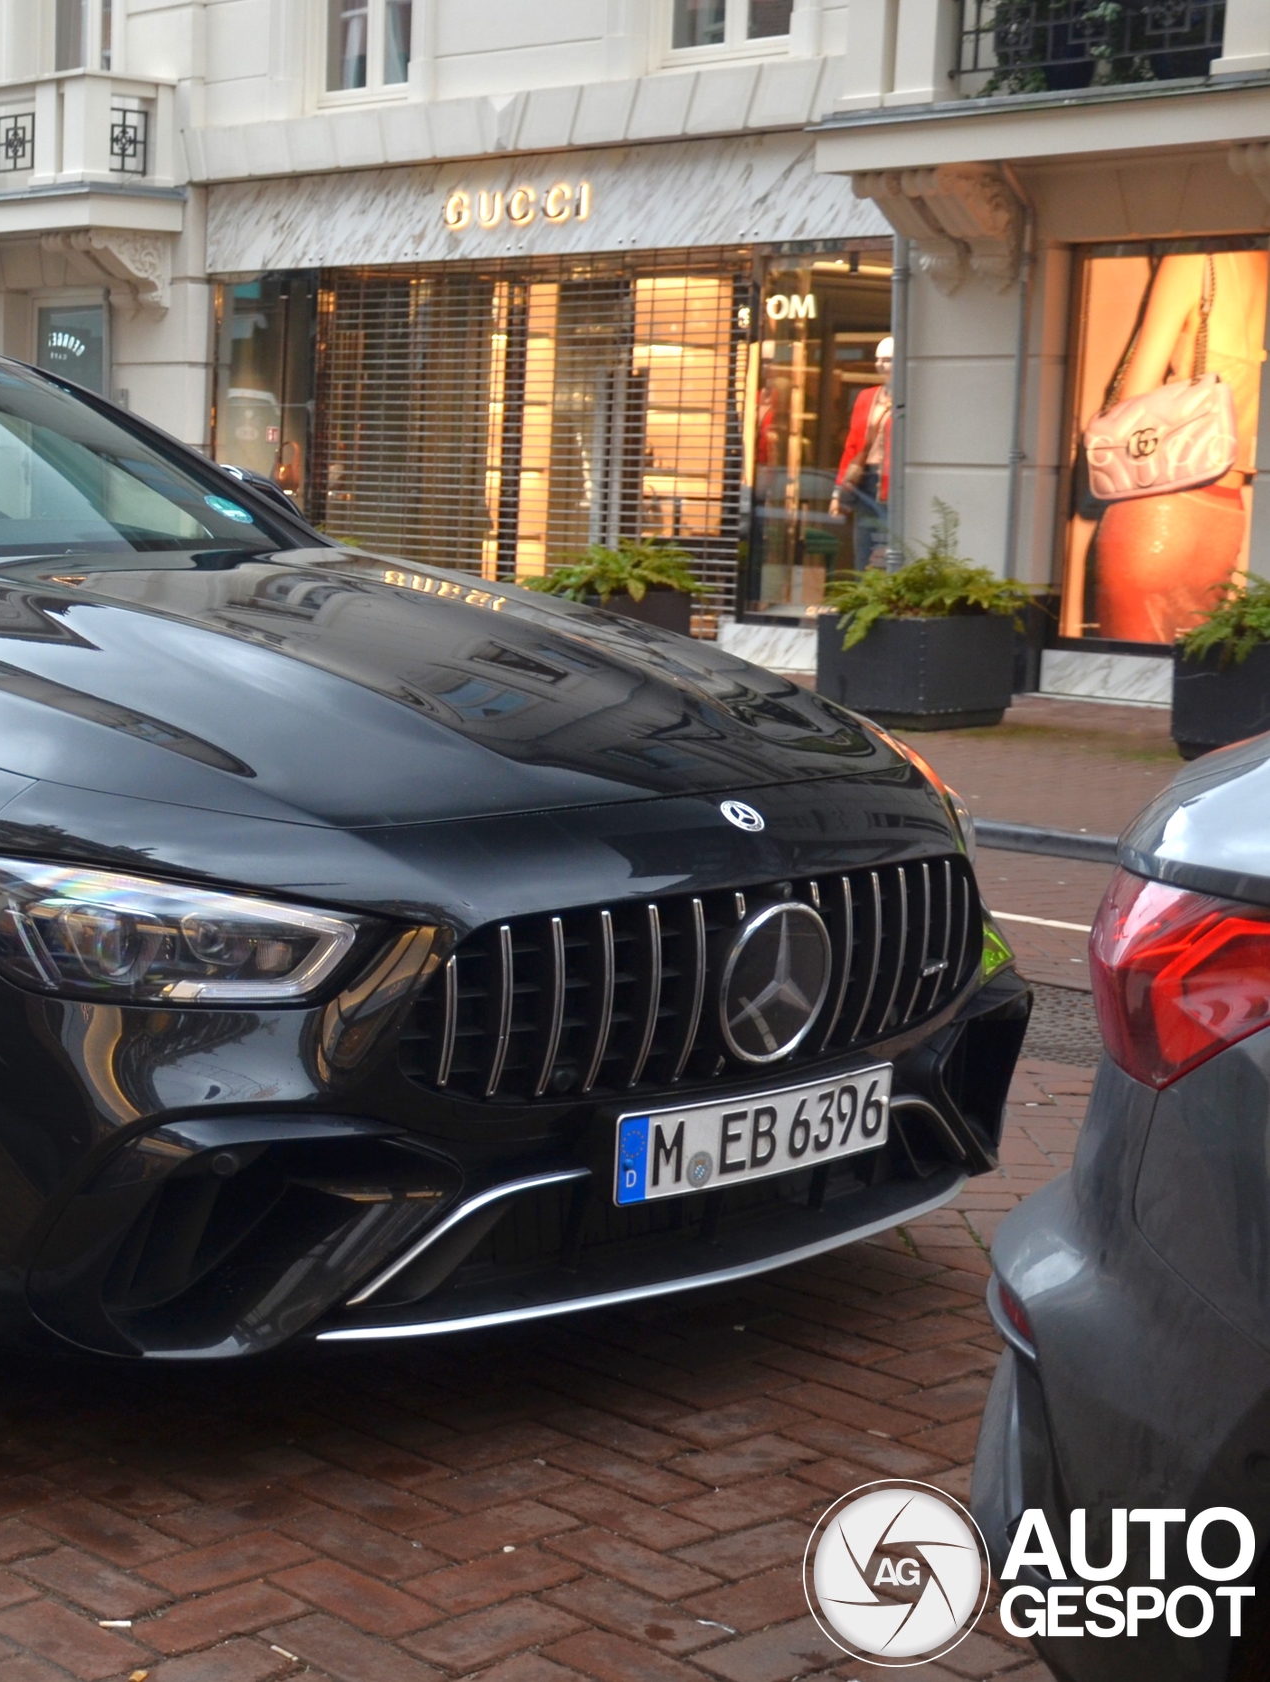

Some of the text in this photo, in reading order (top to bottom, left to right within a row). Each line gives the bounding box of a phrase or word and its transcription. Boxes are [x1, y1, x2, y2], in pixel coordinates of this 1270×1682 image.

[441, 180, 591, 231] GUCCI
[652, 1120, 686, 1187] M
[719, 1105, 777, 1174] EB
[788, 1080, 883, 1157] 6396
[625, 1169, 637, 1188] D
